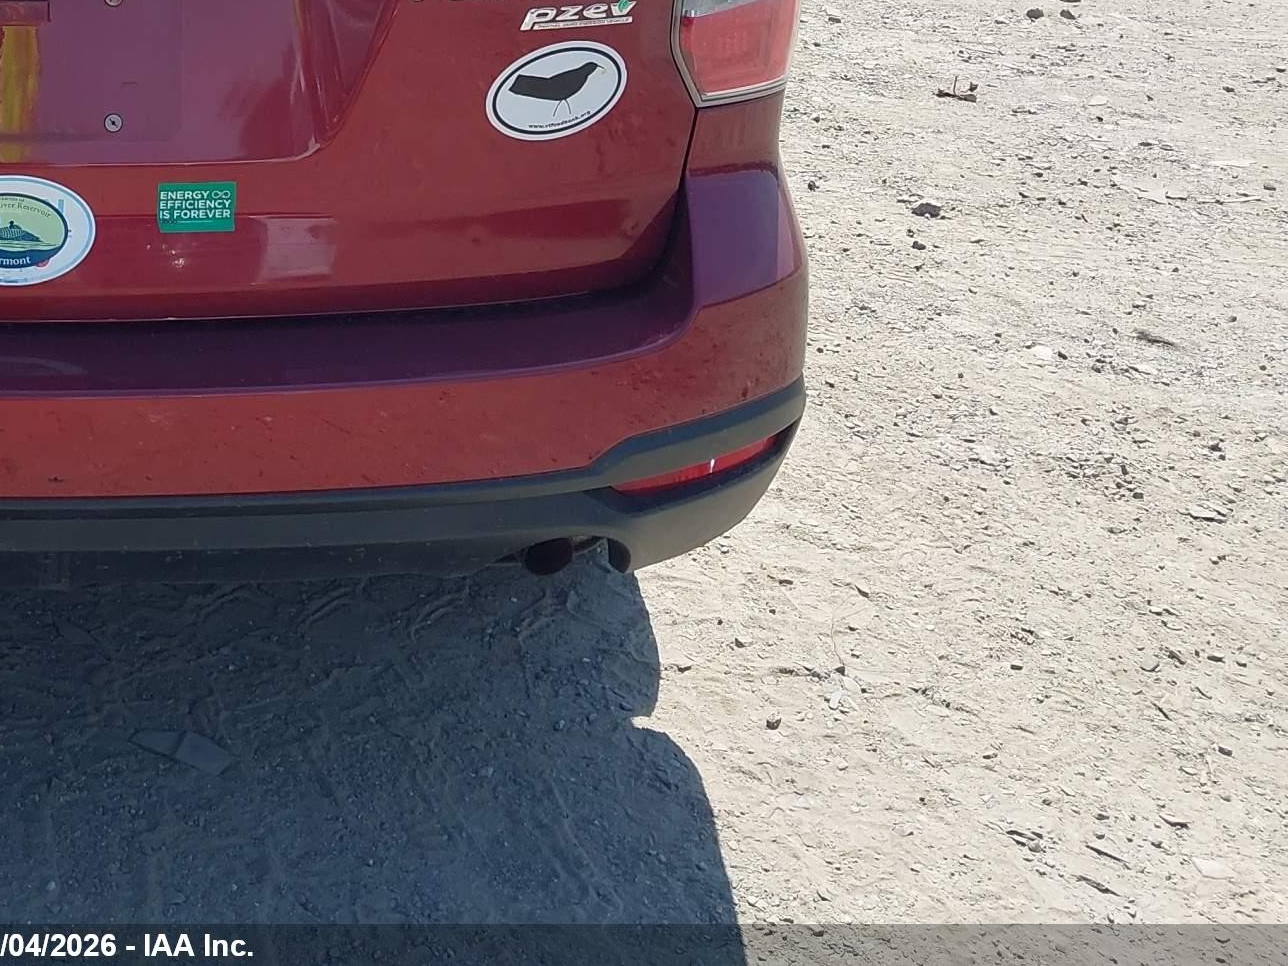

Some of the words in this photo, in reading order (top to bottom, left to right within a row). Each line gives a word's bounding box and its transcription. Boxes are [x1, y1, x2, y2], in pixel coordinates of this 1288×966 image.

[160, 190, 210, 200] ENERGY
[159, 199, 231, 210] EFFICIENCY
[16, 202, 51, 218] Reservoir
[159, 210, 170, 219] IS
[173, 209, 231, 219] FOREVER
